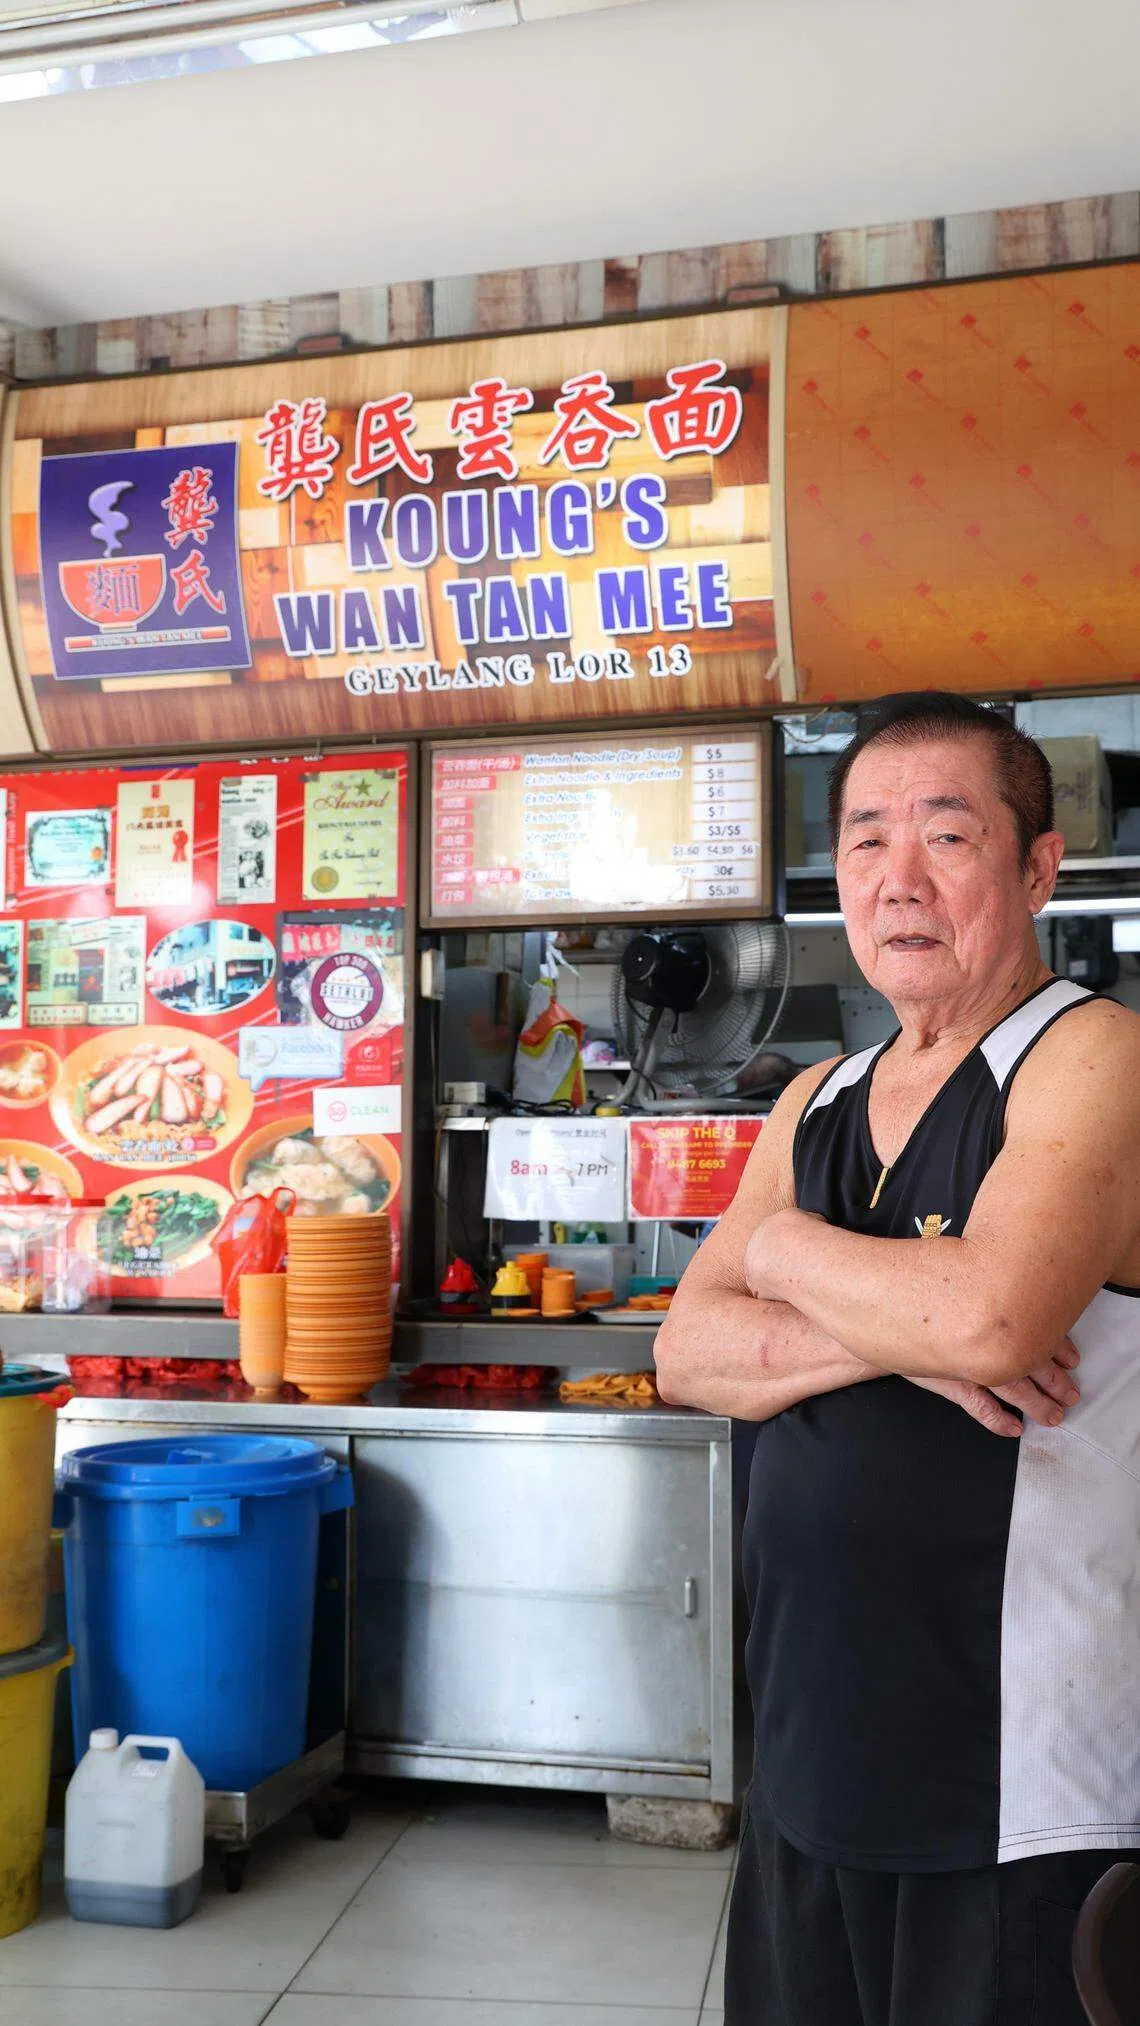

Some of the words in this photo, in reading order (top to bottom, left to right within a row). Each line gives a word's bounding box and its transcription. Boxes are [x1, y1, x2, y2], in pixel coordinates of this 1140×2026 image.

[348, 477, 666, 570] KOUNG'S
[277, 587, 423, 654] WAN
[447, 576, 570, 642] TAN
[599, 563, 732, 632] MEE
[349, 656, 533, 694] GEYLANG
[552, 651, 631, 679] LOR
[652, 647, 691, 674] 13
[708, 825, 741, 837] $3/$5
[351, 1104, 390, 1116] CLEAN
[656, 1127, 690, 1139] SKIP
[693, 1127, 721, 1139] THE
[724, 1126, 737, 1141] Q
